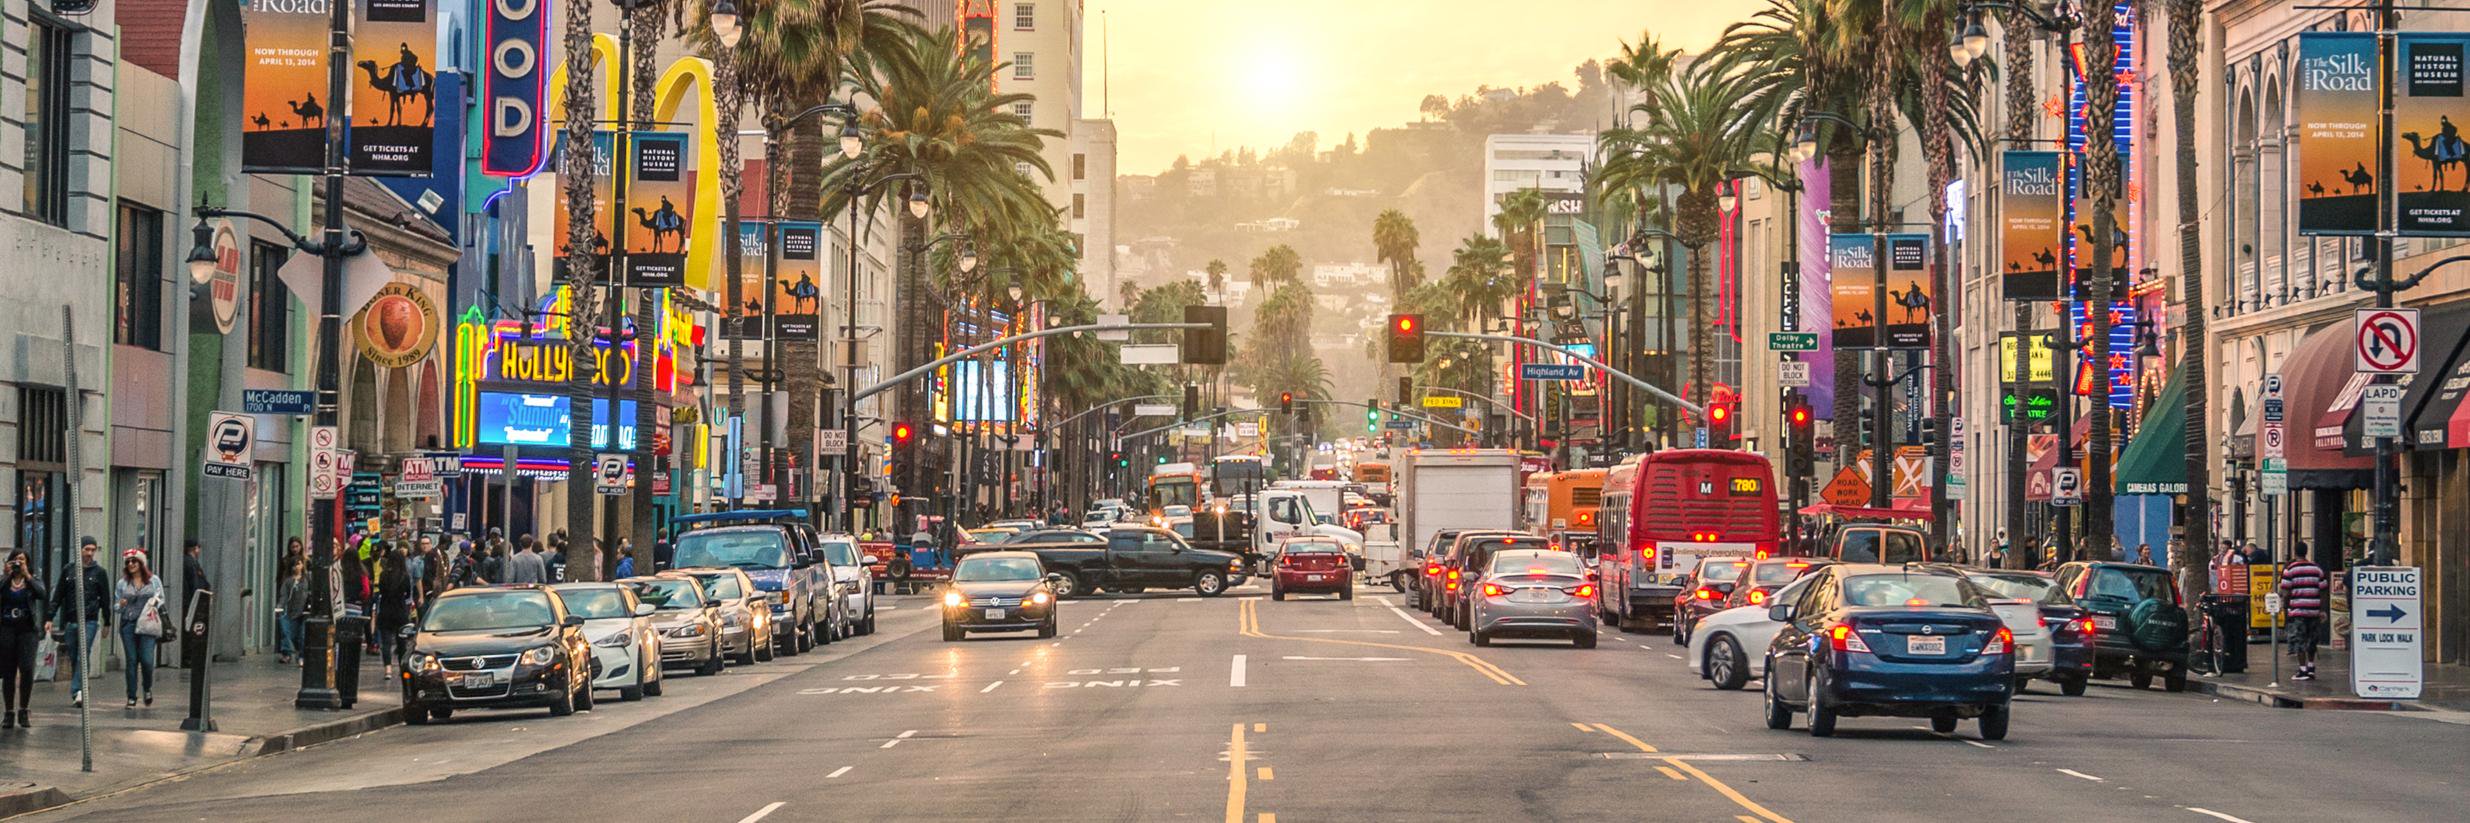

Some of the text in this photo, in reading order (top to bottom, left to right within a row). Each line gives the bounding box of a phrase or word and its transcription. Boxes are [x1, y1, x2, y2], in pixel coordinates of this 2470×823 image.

[255, 48, 319, 57] NOW THROUGH
[259, 58, 282, 66] APRIL
[285, 59, 296, 67] 13,
[2313, 53, 2365, 75] The Silk
[2312, 67, 2372, 91] Road
[2307, 122, 2366, 130] NOW THROUGH
[2013, 167, 2050, 183] The Silk
[2013, 178, 2056, 195] Road
[1847, 246, 1869, 259] Silk
[1839, 254, 1873, 268] Road
[1776, 334, 1799, 342] Dolby
[366, 346, 421, 366] Since 1989
[1527, 367, 1579, 377] Highland Av
[246, 390, 301, 404] McCadden
[2366, 388, 2398, 398] LAPD
[246, 402, 311, 412] 1700 N Pl
[824, 431, 846, 439] DO NOT
[206, 465, 248, 478] PAY HERE
[405, 460, 432, 475] ATM
[1701, 482, 1712, 494] M
[1734, 479, 1757, 491] 780
[2127, 482, 2157, 493] CAMERAS
[556, 568, 564, 581] 5
[2357, 573, 2416, 583] PUBLIC
[2356, 586, 2416, 596] PARKING
[2361, 633, 2413, 643] PARK LOCK WALK
[796, 684, 943, 694] XING
[1043, 678, 1183, 689] XING
